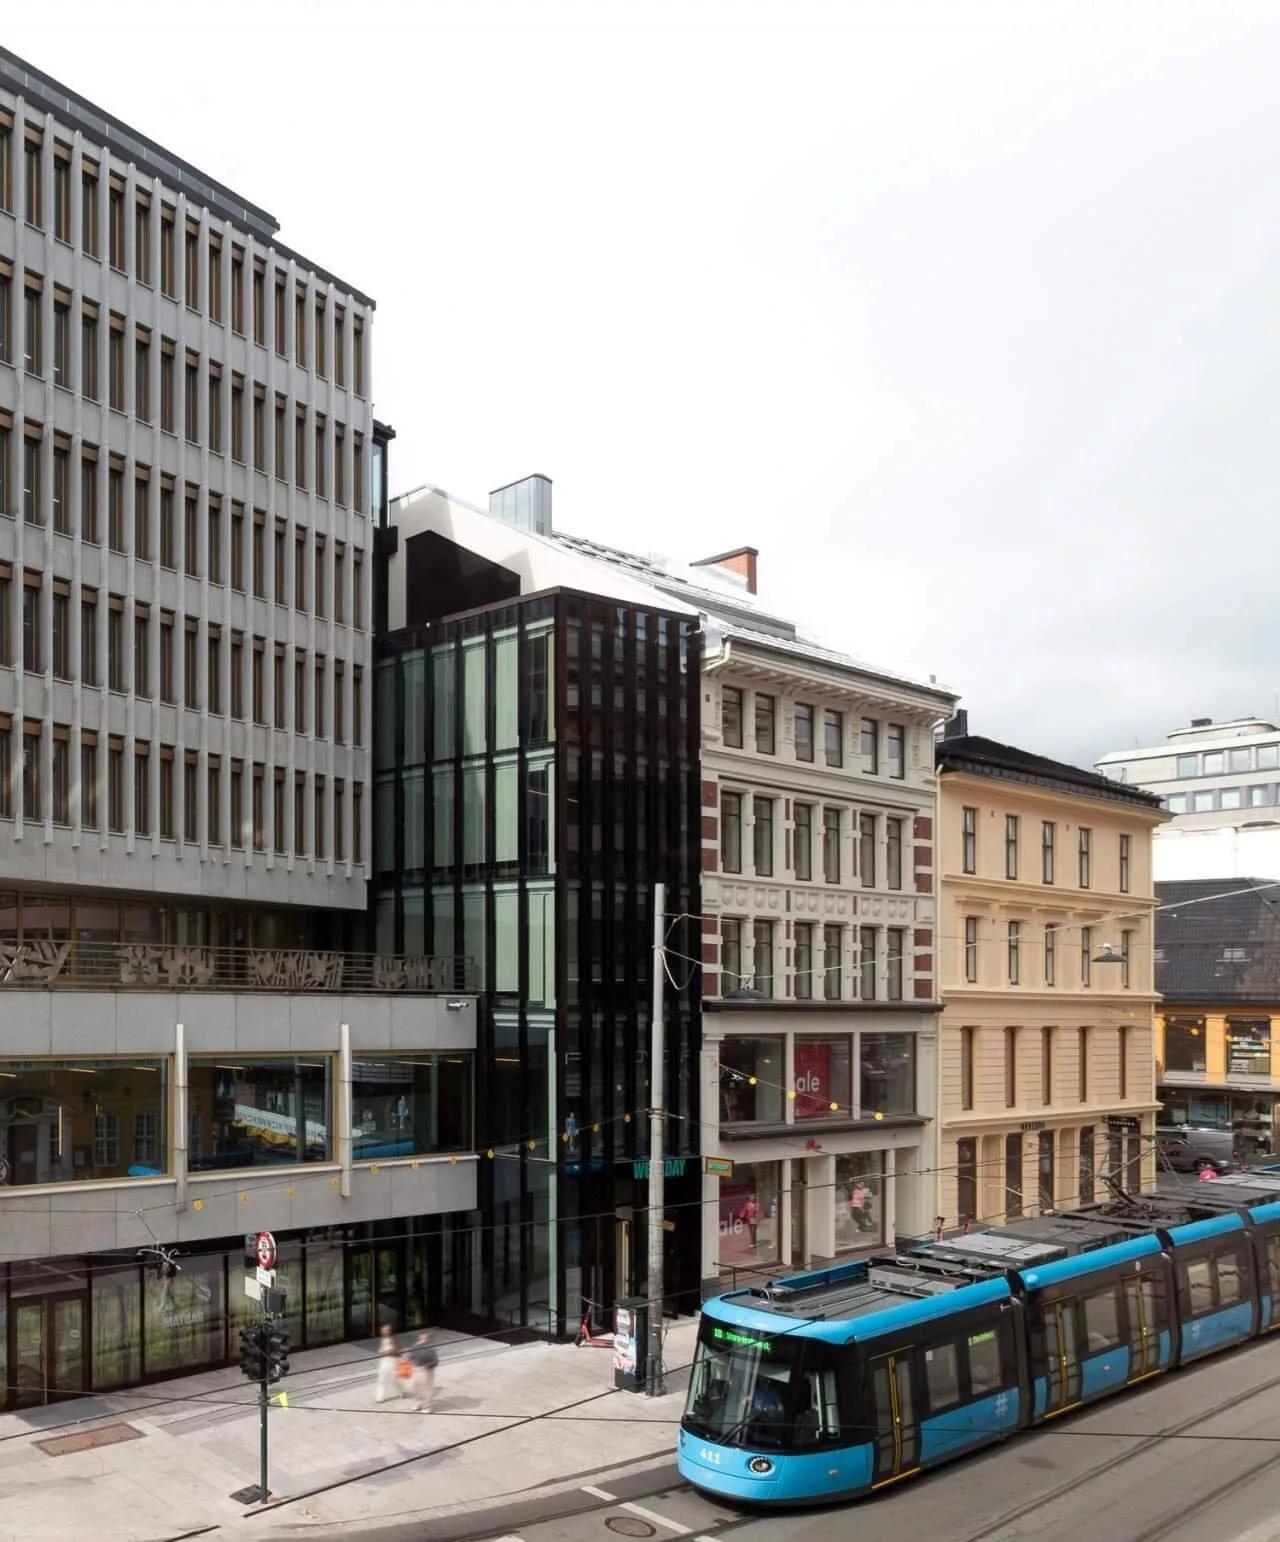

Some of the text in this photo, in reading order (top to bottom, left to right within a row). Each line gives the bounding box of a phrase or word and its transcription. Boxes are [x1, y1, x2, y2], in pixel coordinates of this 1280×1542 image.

[795, 1070, 821, 1092] ale
[633, 1159, 686, 1179] WEDAY
[720, 1211, 743, 1236] ale
[700, 1447, 721, 1465] 411
